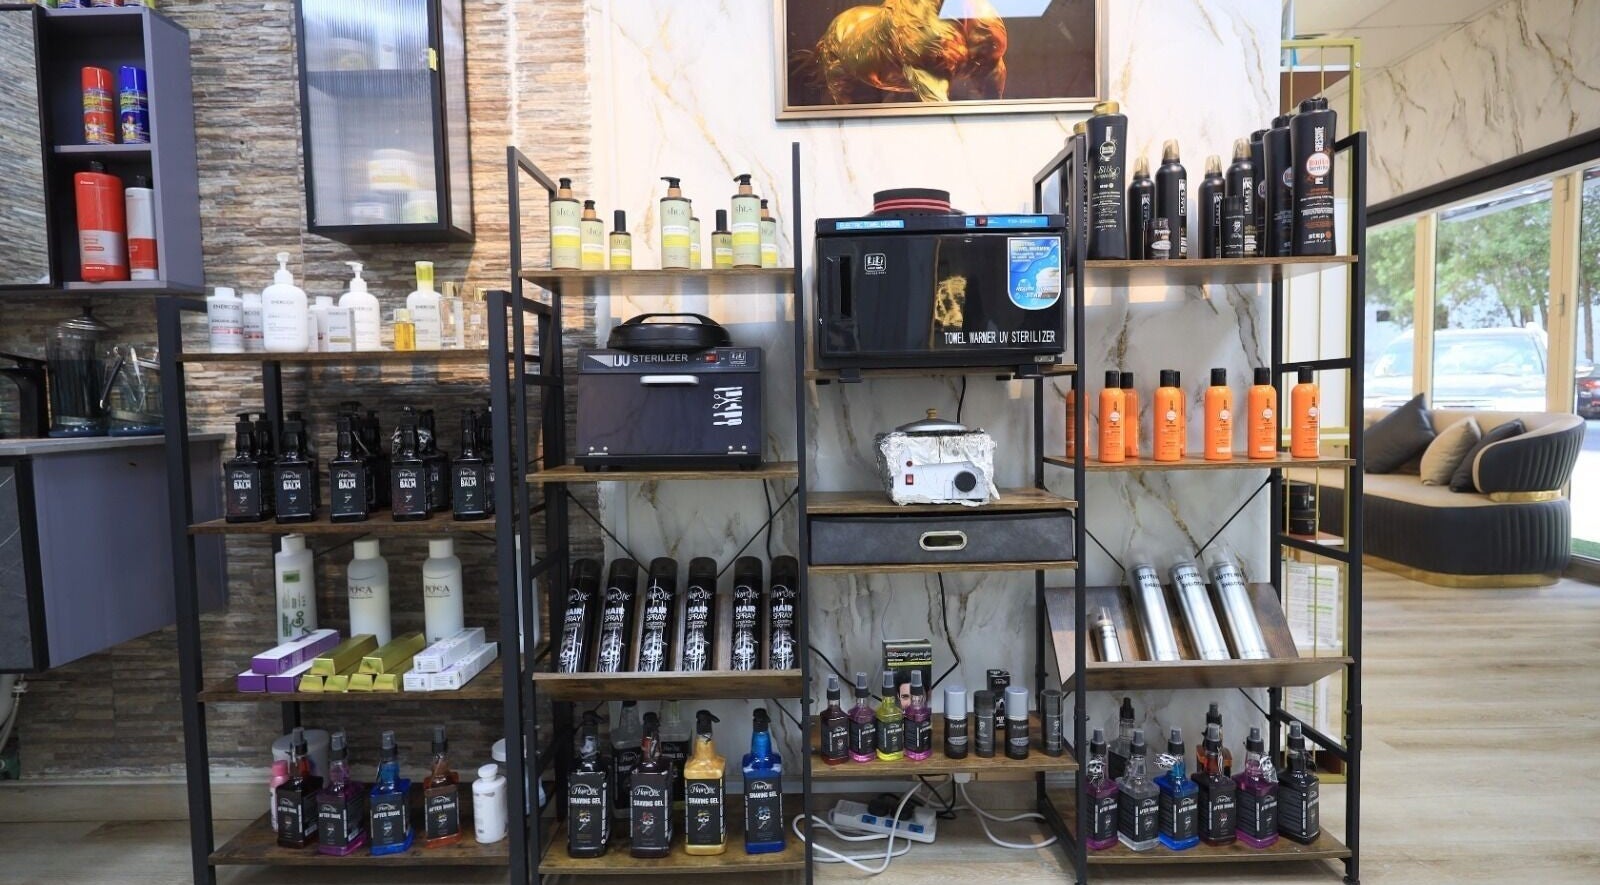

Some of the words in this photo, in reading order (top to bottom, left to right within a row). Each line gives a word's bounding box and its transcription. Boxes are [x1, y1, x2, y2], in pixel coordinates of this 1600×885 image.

[944, 332, 966, 344] TOWEL
[1000, 331, 1009, 343] UV
[1012, 330, 1055, 342] STERILIZER
[632, 354, 688, 363] STERILIZER
[234, 482, 251, 490] BALM
[283, 482, 301, 490] BALM
